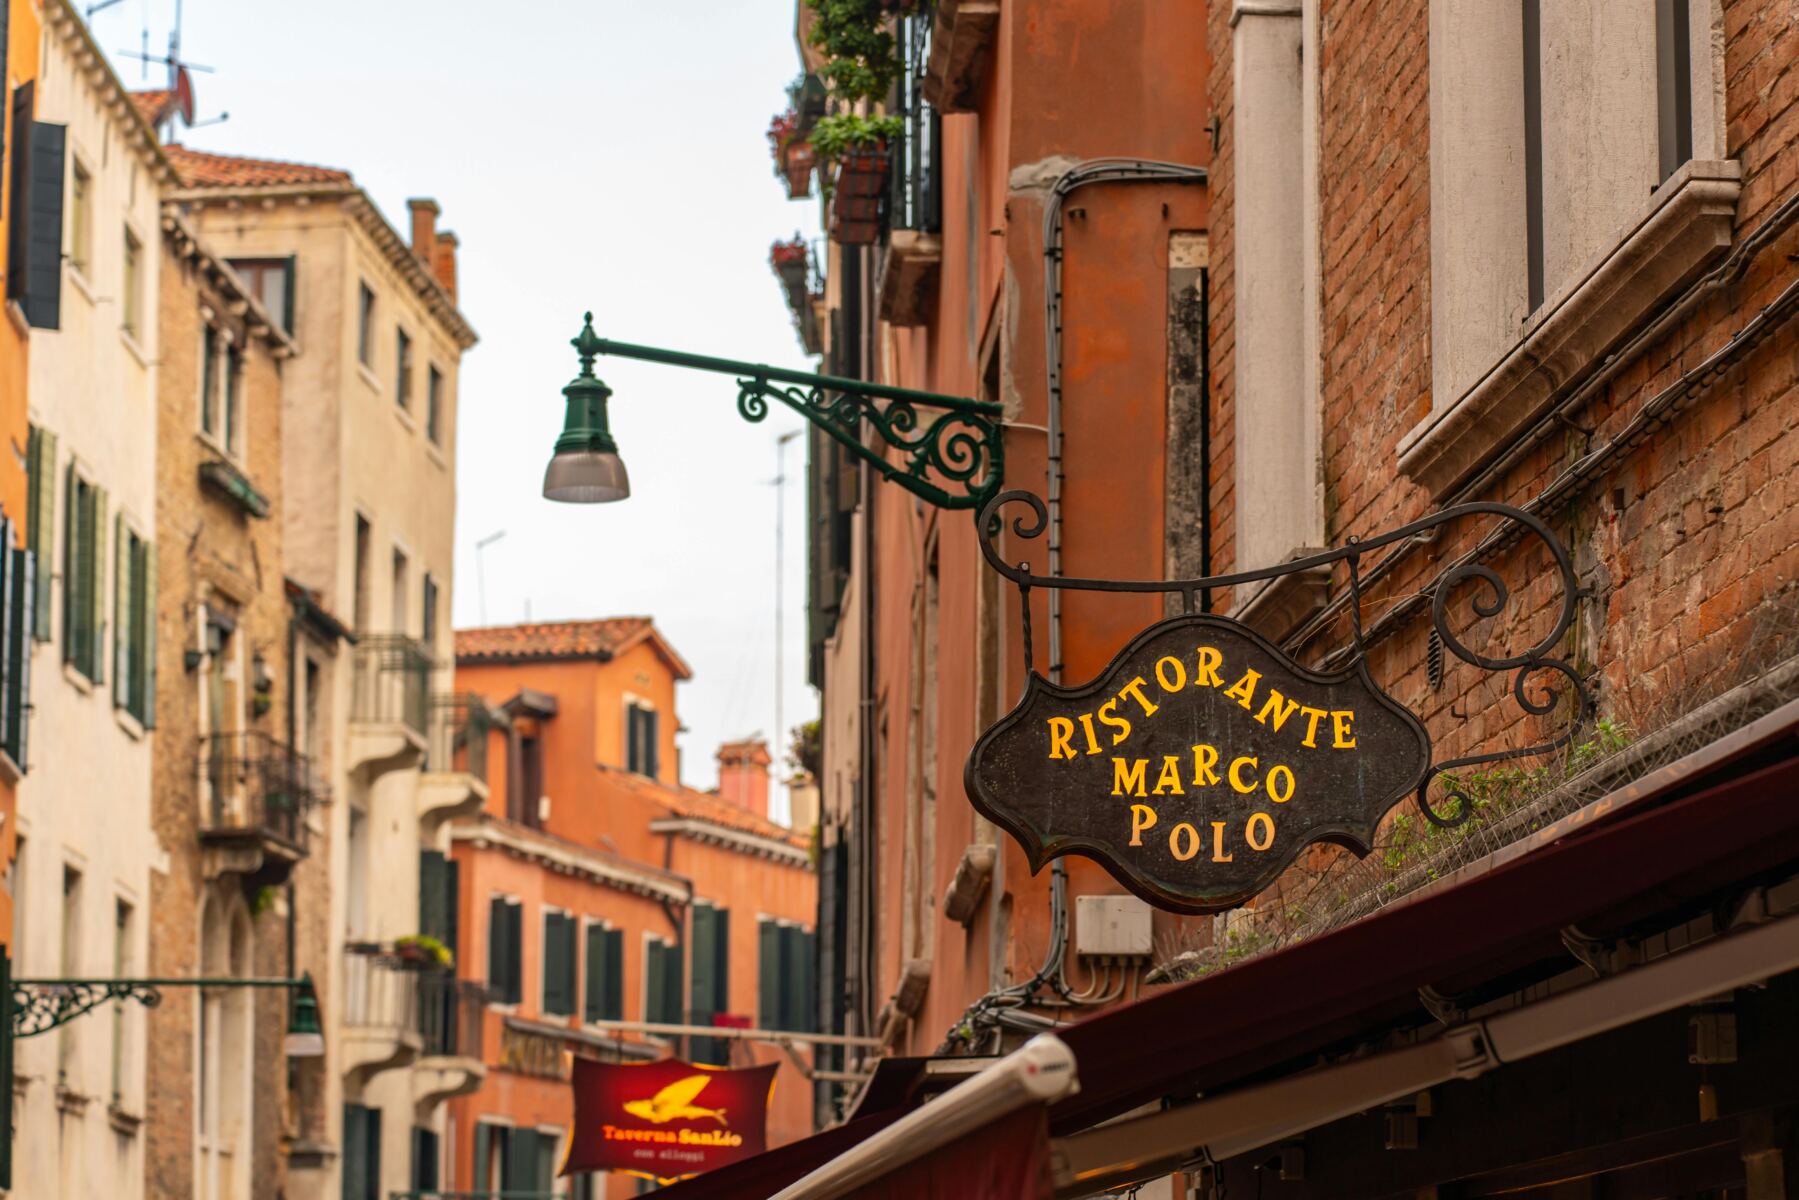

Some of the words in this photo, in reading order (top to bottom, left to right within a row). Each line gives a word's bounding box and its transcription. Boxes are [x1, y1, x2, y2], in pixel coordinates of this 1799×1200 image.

[1047, 646, 1357, 761] RISTORANTE
[1111, 744, 1296, 803] MARCO
[1128, 804, 1276, 863] POLO
[602, 1125, 677, 1143] Taverna
